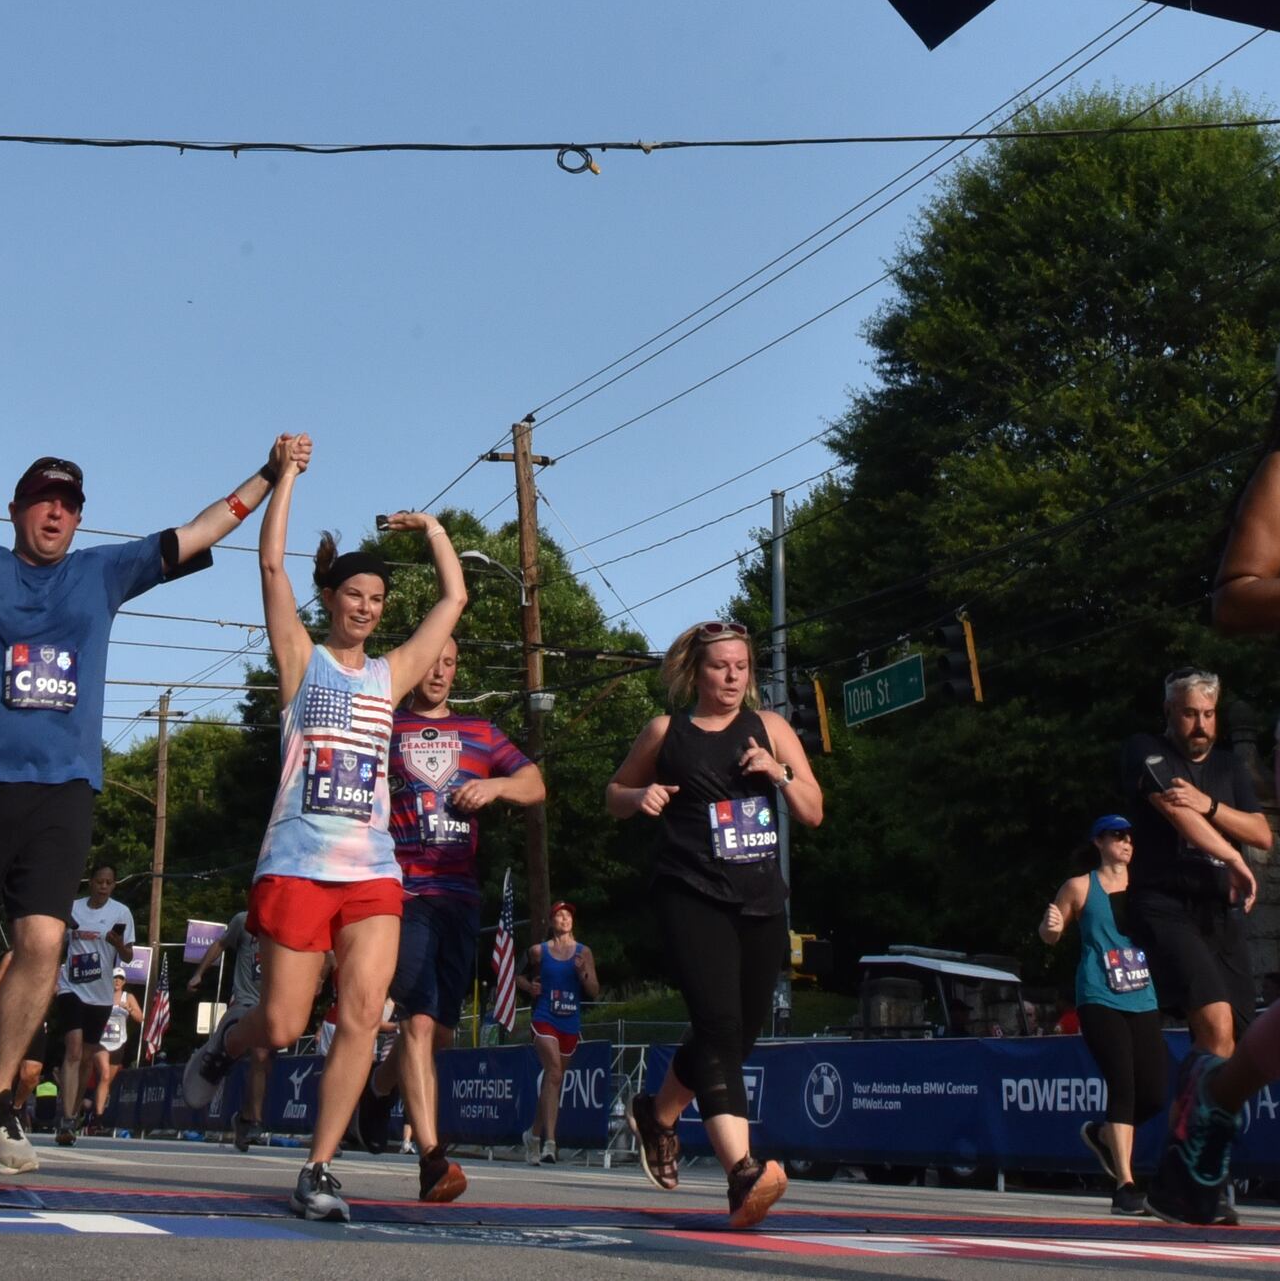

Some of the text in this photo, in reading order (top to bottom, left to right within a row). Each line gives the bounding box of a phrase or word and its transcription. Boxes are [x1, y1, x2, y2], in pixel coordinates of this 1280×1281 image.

[15, 670, 32, 692] C
[36, 677, 77, 696] 9052
[848, 678, 890, 717] 10th St
[401, 741, 461, 750] PEACHTREE
[318, 777, 331, 798] E
[336, 786, 374, 805] 15612
[428, 814, 438, 832] F
[724, 827, 737, 849] E
[742, 831, 777, 847] 15280
[191, 936, 214, 946] DASA
[1115, 968, 1123, 982] F
[452, 1078, 513, 1100] NORTHSIDE
[559, 1068, 606, 1110] PNC
[852, 1081, 979, 1095] Your Atlanta Area BMW Centers
[1001, 1077, 1108, 1113] POWERA
[460, 1104, 499, 1119] HOSPITAL
[852, 1097, 902, 1111] BMWatl.com
